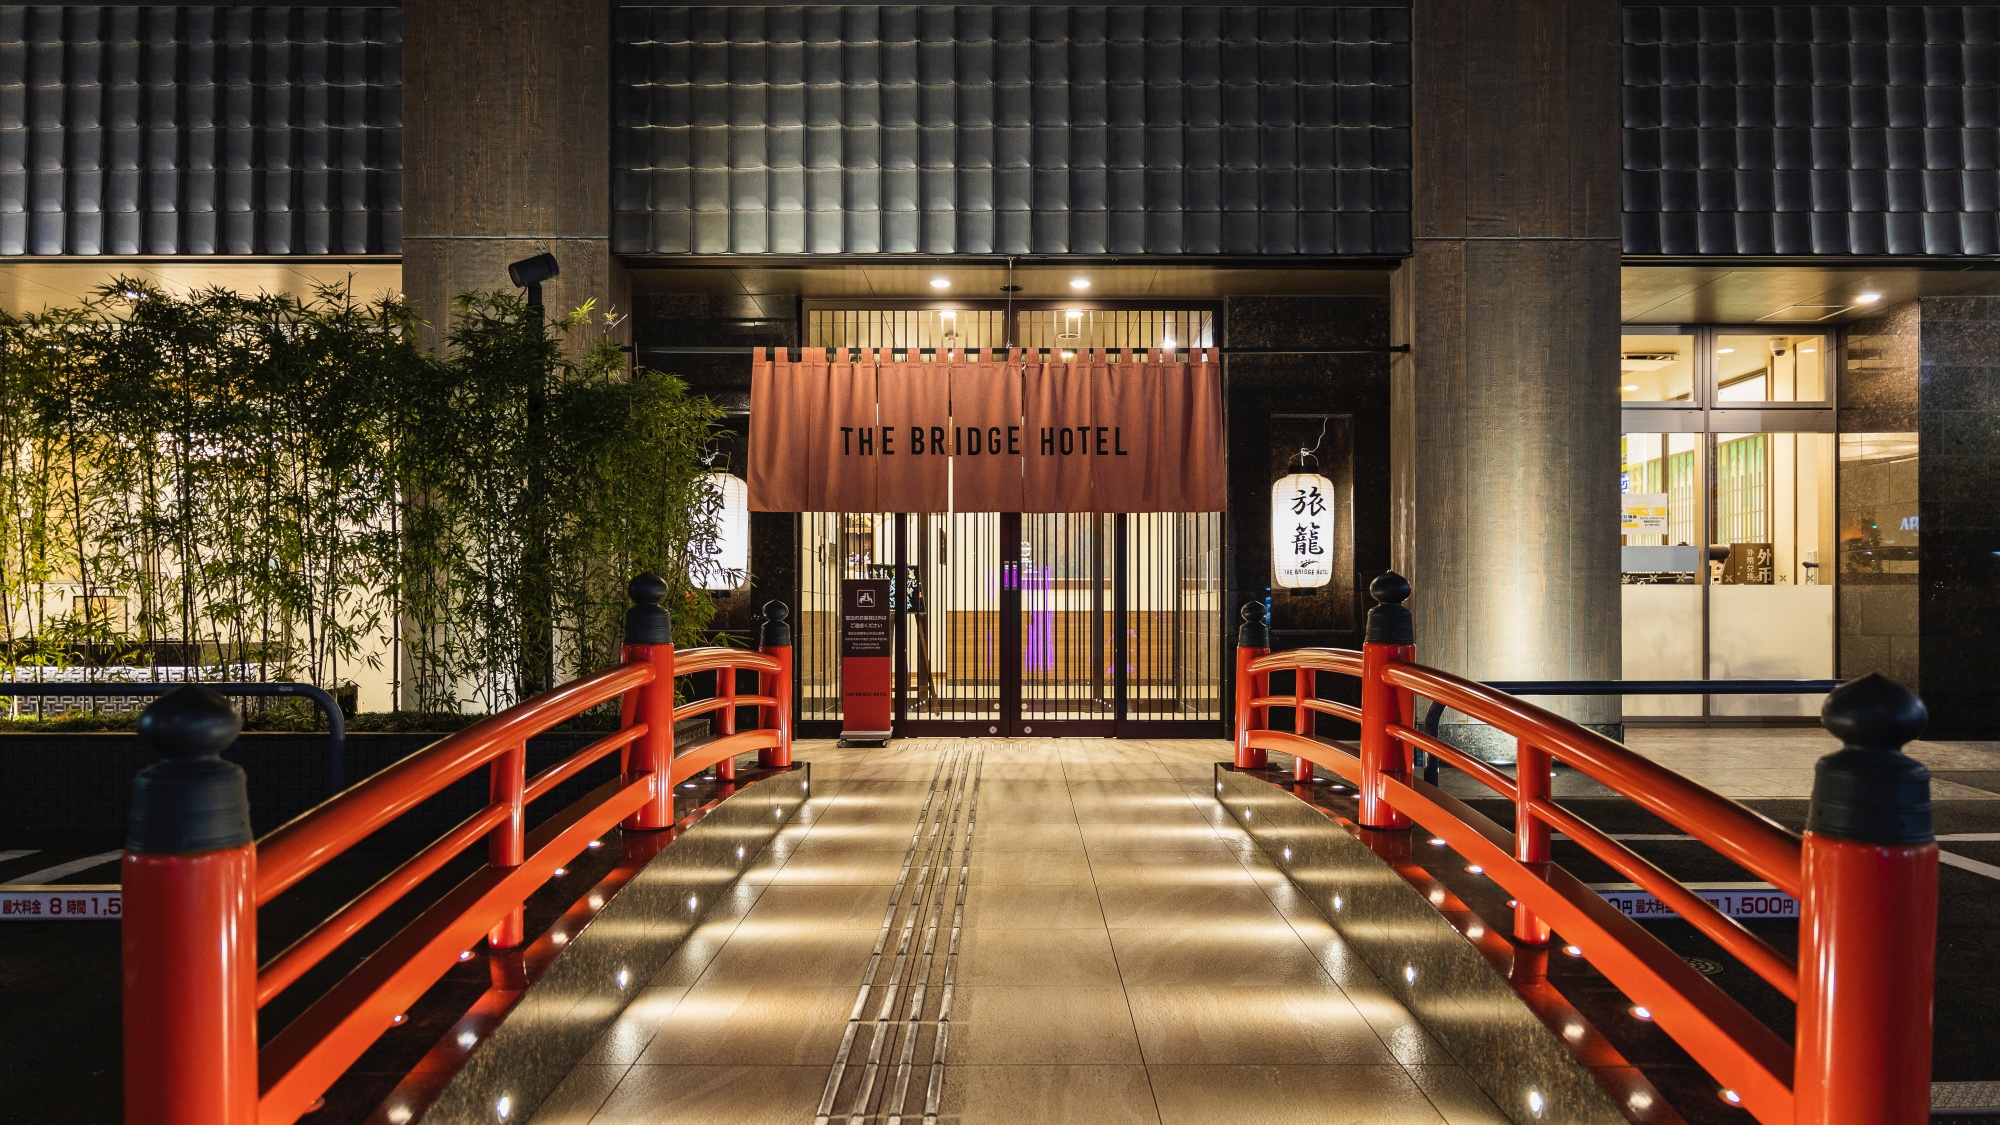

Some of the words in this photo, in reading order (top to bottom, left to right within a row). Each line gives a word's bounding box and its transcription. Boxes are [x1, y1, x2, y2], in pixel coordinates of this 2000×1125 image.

[840, 426, 895, 456] THE
[910, 426, 1020, 456] BRIDGE
[1040, 426, 1128, 456] HOTEL
[1900, 515, 1919, 531] AP
[1294, 568, 1315, 576] BRIDGE
[2, 899, 42, 915] 最大料金
[49, 897, 63, 915] 8
[66, 899, 87, 915] 時間
[1724, 896, 1794, 915] 1,500円
